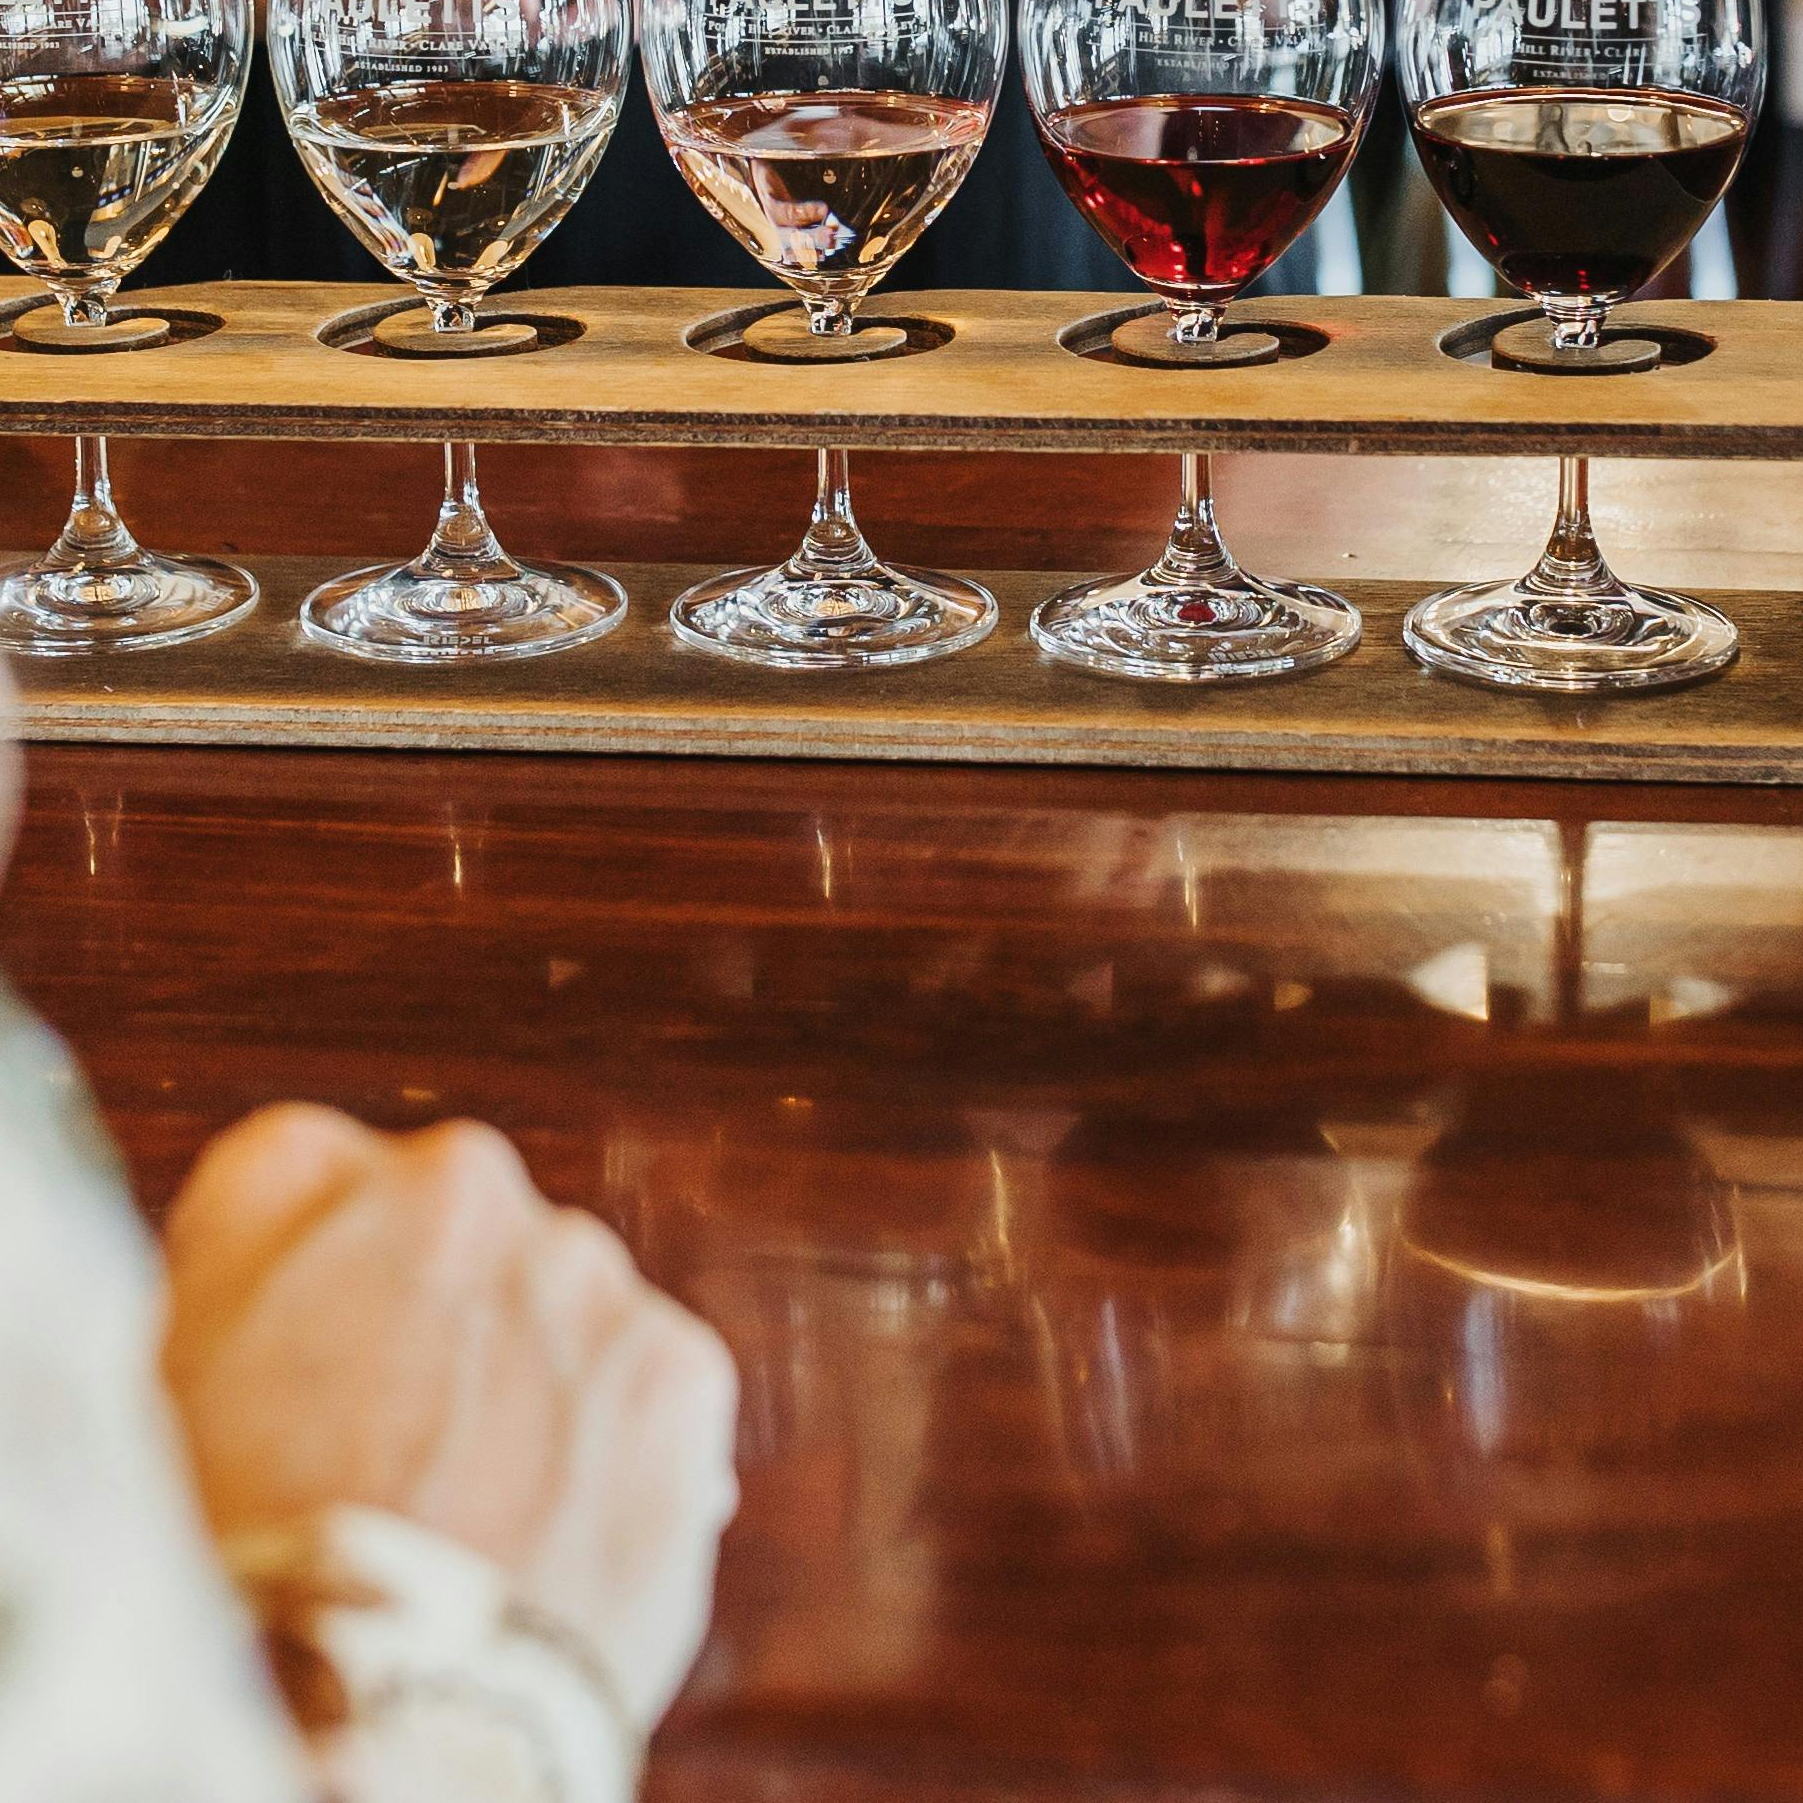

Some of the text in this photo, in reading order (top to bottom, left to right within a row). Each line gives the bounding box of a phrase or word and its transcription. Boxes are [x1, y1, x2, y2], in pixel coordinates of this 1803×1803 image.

[827, 24, 868, 35] CLA
[420, 39, 464, 52] CLARE
[1174, 33, 1215, 47] RIVER
[1550, 44, 1591, 57] RIVER
